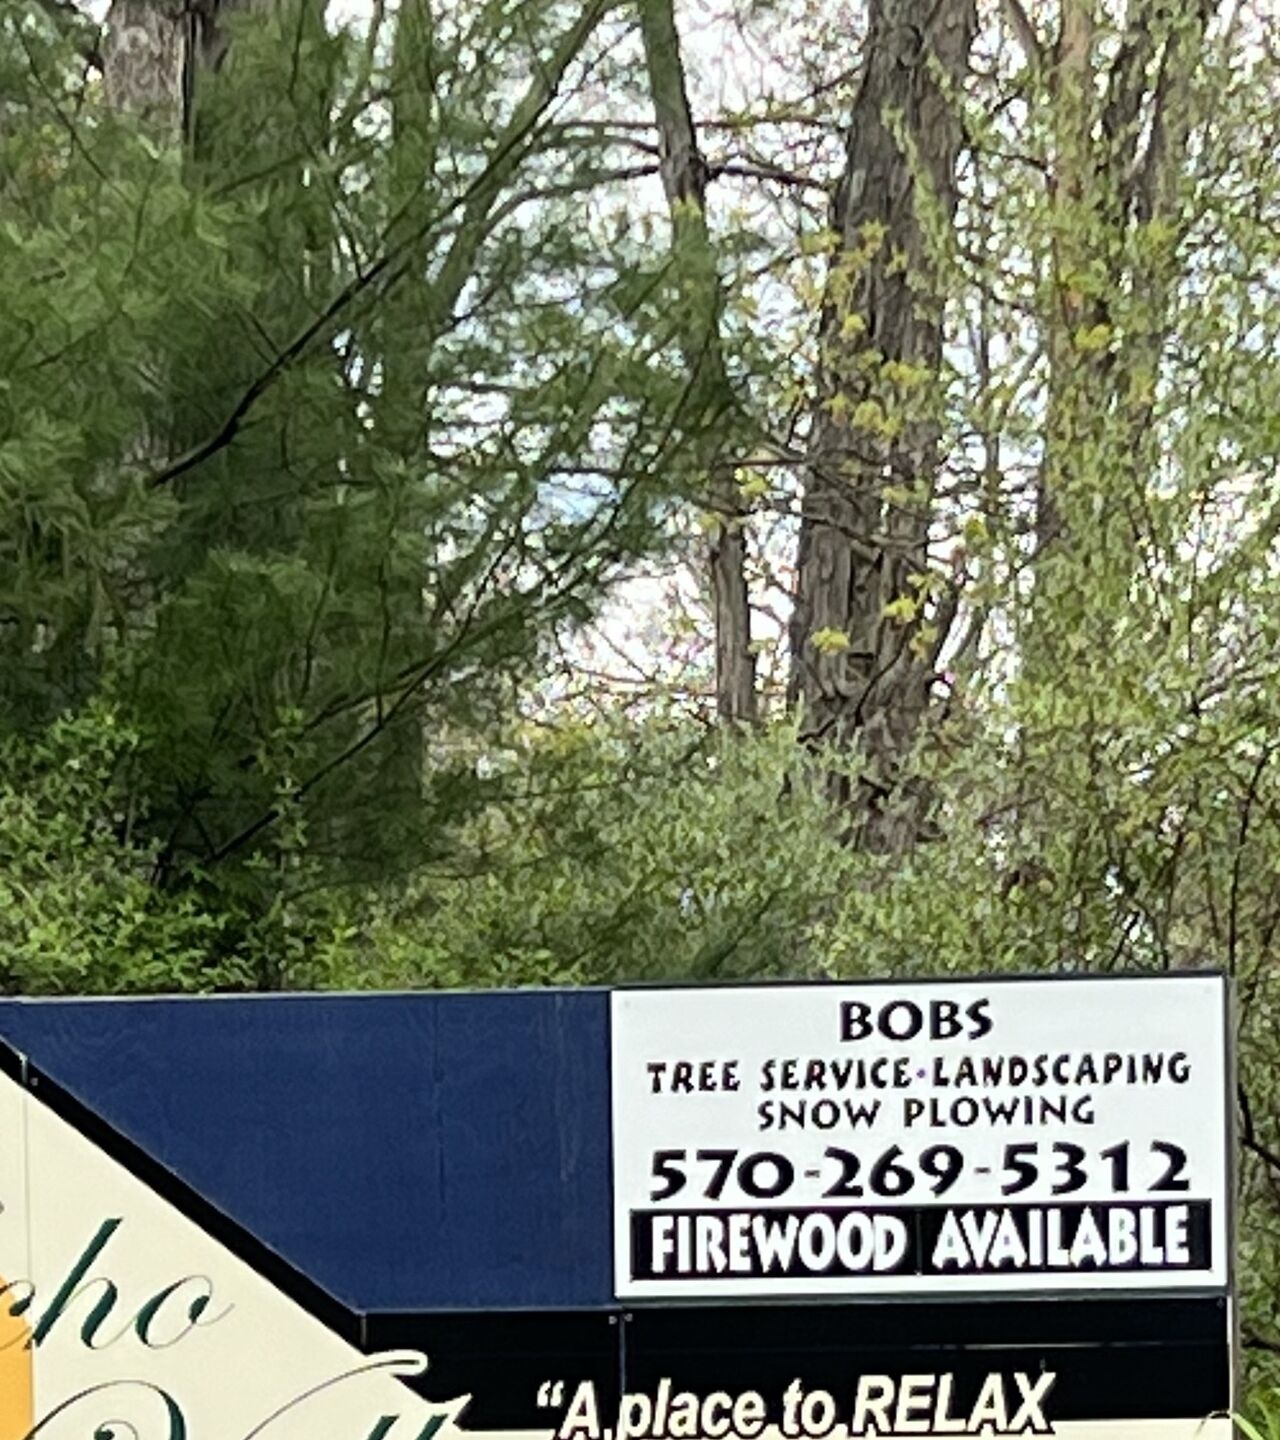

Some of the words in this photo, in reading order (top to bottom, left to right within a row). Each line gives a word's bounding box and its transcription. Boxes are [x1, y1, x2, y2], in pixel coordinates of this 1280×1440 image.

[839, 997, 993, 1043] BOBS
[646, 1059, 741, 1094] TREE
[757, 1098, 882, 1131] SNOW
[903, 1094, 1096, 1128] PLOWING
[650, 1140, 1191, 1202] 570-269-5312
[651, 1212, 908, 1273] FIREWOOD
[932, 1205, 1190, 1270] AVAILABLE
[782, 1382, 837, 1439] to
[849, 1371, 1058, 1435] RELAX
